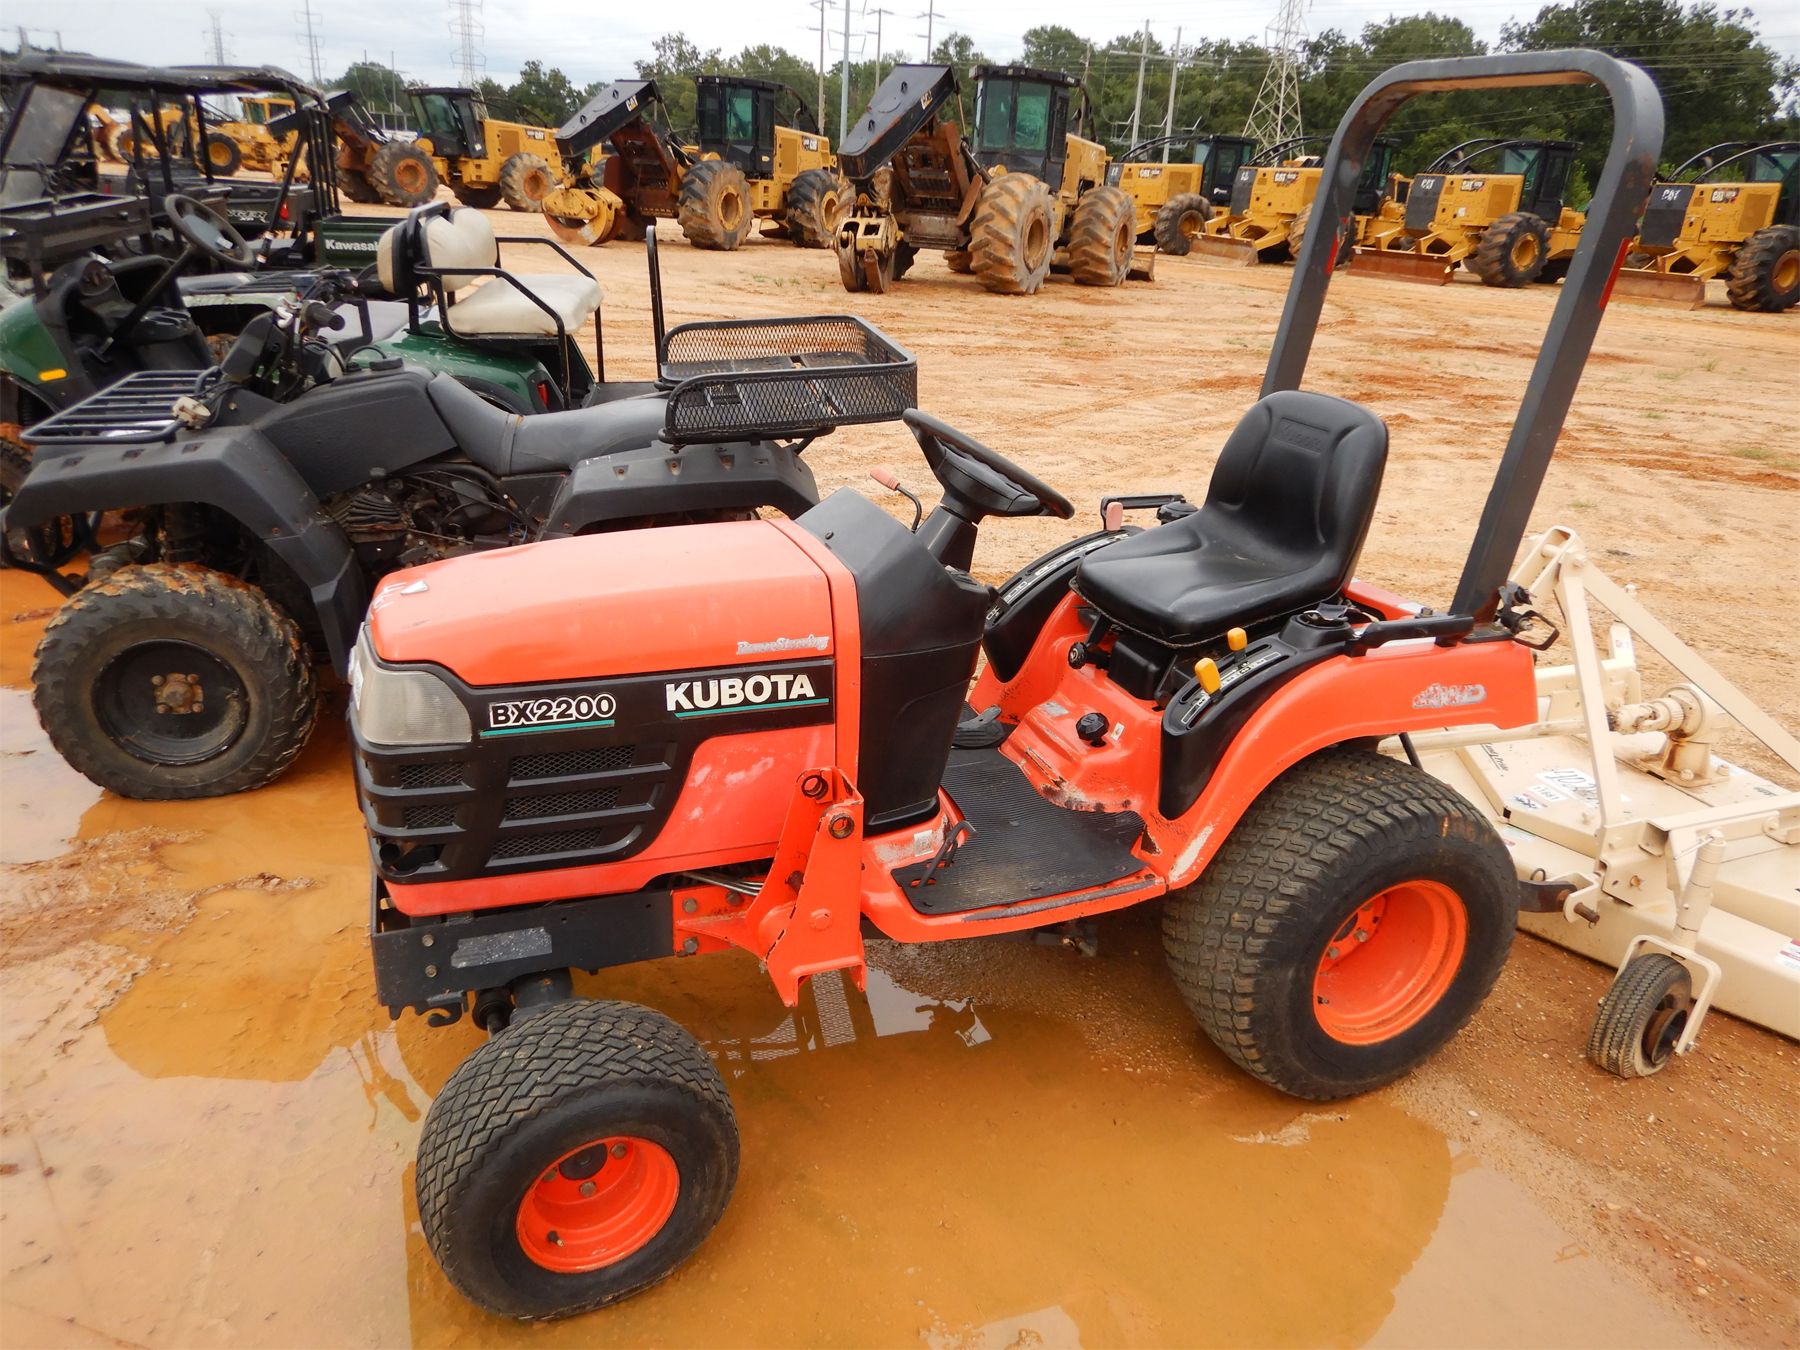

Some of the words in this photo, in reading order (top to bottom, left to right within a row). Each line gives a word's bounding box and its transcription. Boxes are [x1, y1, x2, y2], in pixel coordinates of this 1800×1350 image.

[625, 95, 638, 112] CAT
[1660, 189, 1681, 201] CAT
[665, 674, 816, 711] KUBOTA
[488, 693, 617, 728] BX2200
